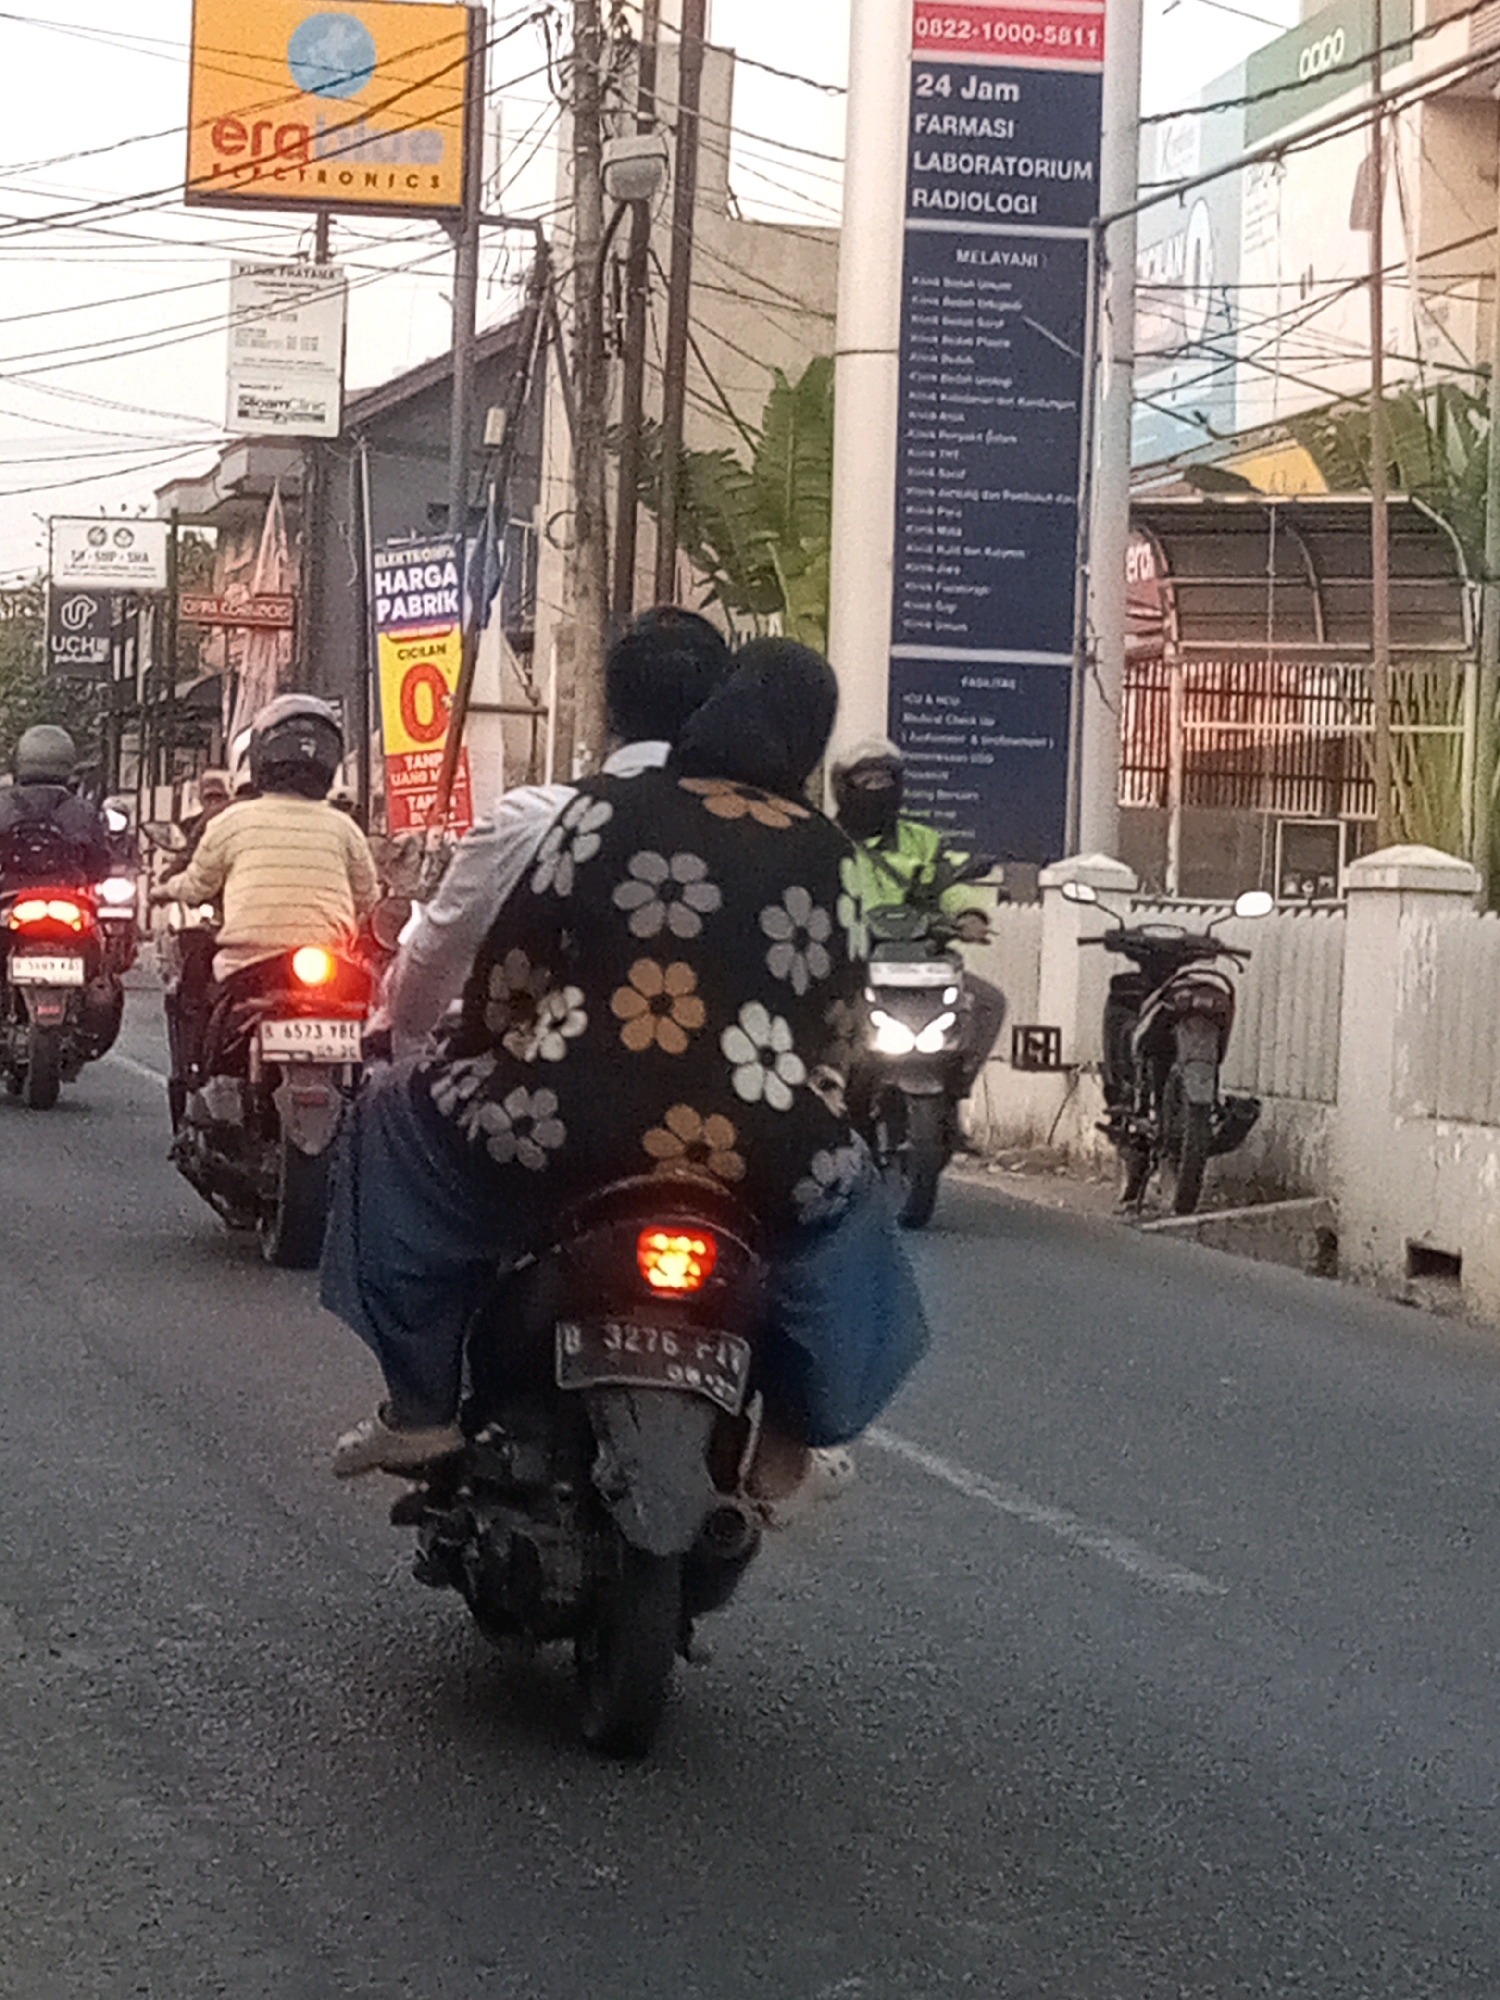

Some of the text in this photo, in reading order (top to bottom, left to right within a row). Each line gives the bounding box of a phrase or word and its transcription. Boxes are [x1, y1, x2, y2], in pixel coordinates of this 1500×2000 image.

[915, 17, 1099, 47] 0822-1000-5811
[915, 74, 1020, 102] 24 Jam
[915, 113, 1015, 138] FARMASI
[913, 151, 1093, 180] LABORATORIUM
[911, 189, 1038, 213] RADIOLOGI
[956, 249, 1039, 268] MELAYANI
[375, 562, 458, 596] HARGA
[377, 589, 459, 622] PABRIK
[400, 662, 451, 744] 0
[403, 752, 445, 771] TANP
